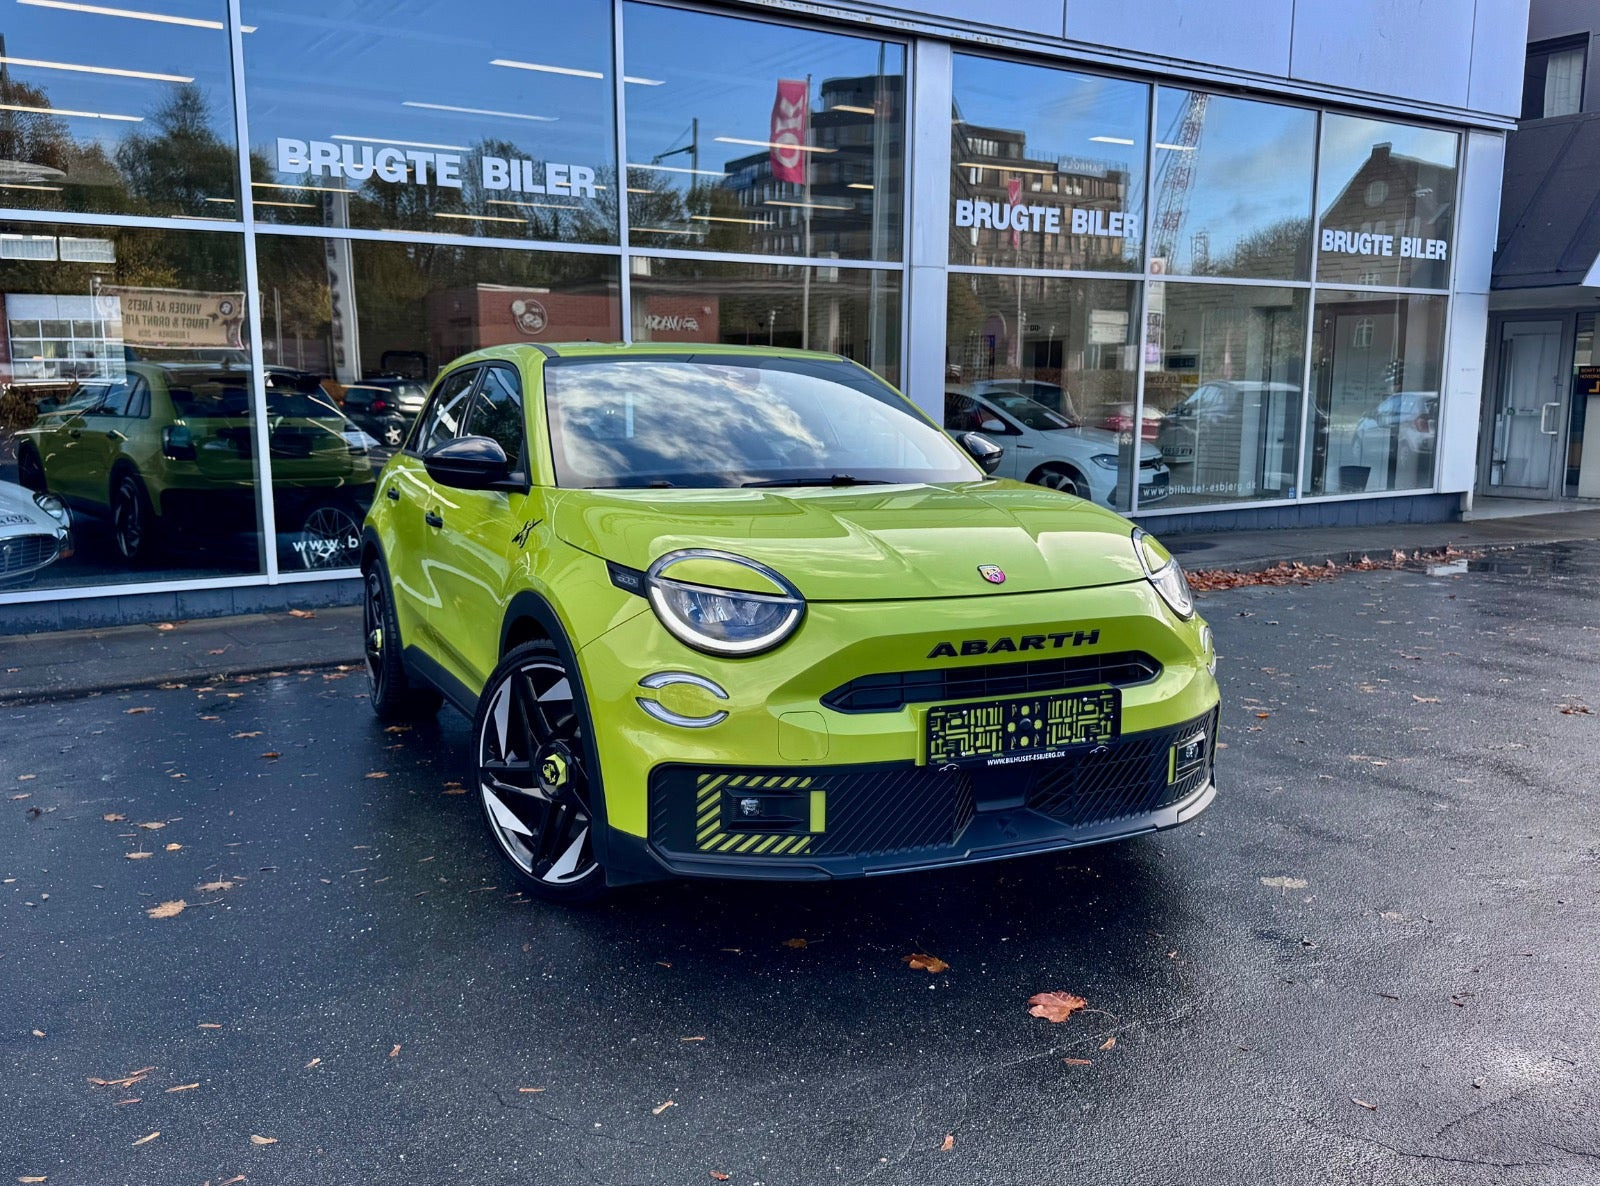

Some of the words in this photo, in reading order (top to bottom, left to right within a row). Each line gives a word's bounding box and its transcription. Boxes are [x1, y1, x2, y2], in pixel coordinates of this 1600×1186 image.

[276, 137, 463, 189] BRUGTE
[481, 155, 596, 198] BILER
[955, 199, 1060, 234] BRUGTE
[1071, 208, 1139, 237] BILER
[1321, 229, 1394, 256] BRUGTE
[1400, 236, 1447, 260] BILER
[926, 629, 1100, 659] ABARTH
[987, 751, 1066, 766] WWW.BILHUSET-ESBJERG.DK
